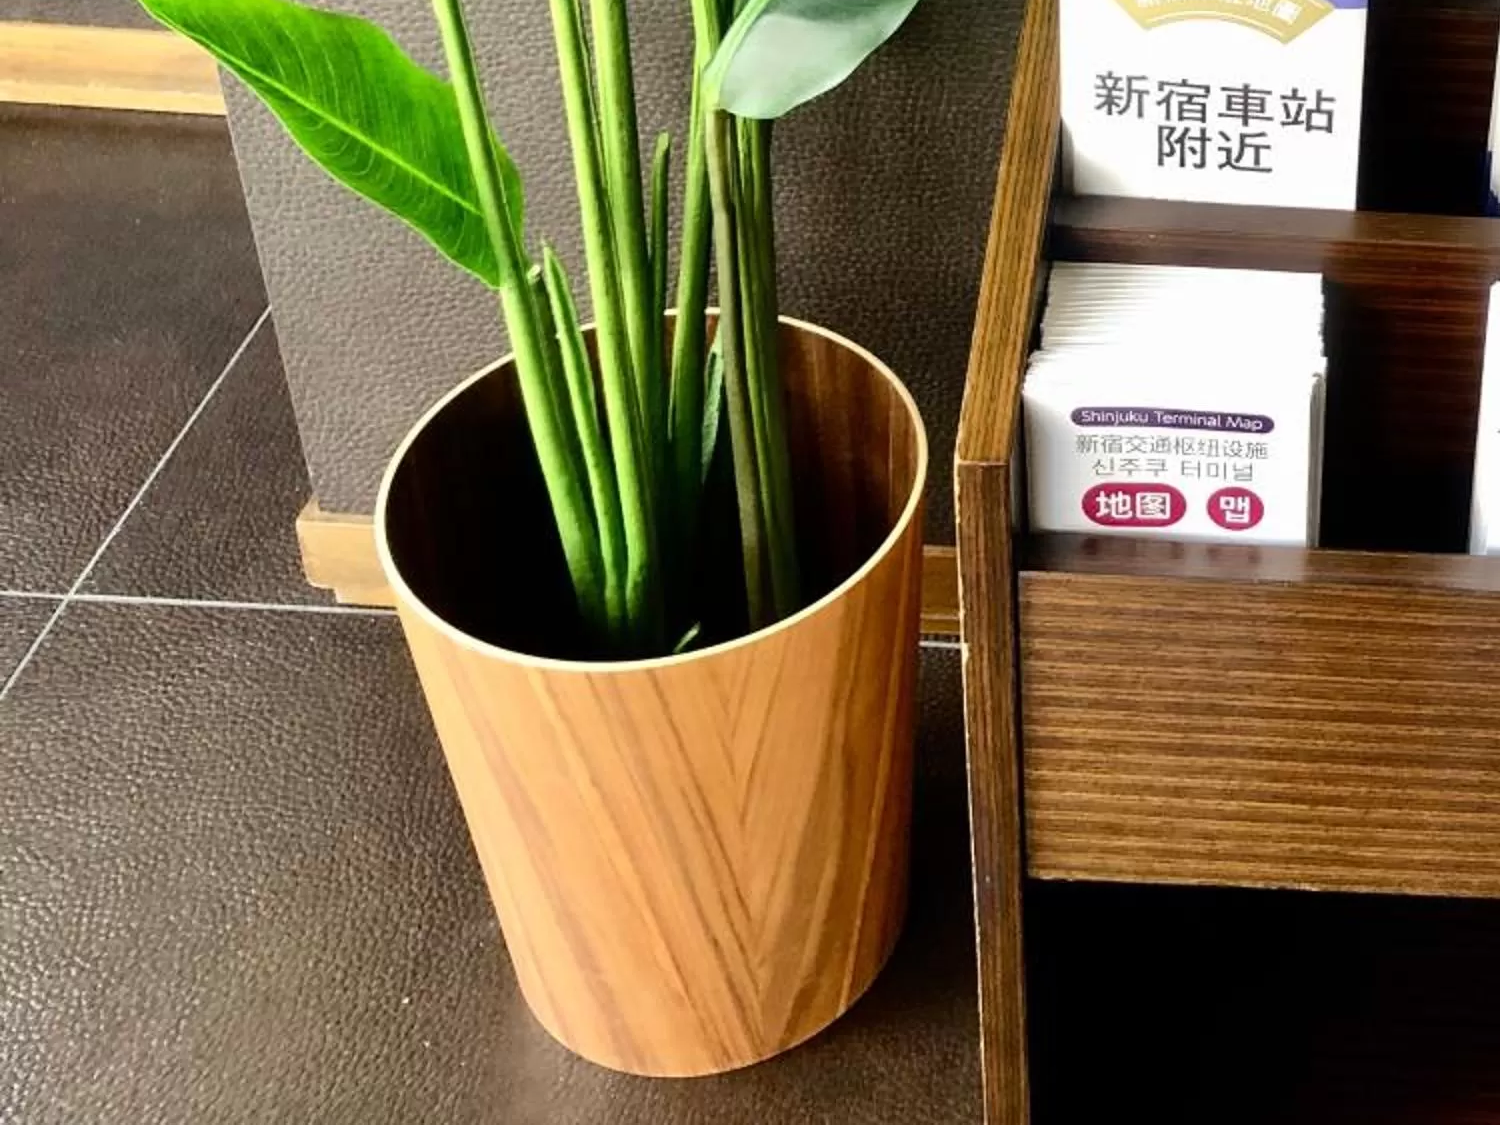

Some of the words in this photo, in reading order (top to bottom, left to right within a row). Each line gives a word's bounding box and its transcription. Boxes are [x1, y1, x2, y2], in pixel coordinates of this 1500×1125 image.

[1093, 70, 1337, 135] 新宿車站
[1157, 124, 1273, 174] 附近
[1081, 410, 1149, 426] Shinjuku
[1154, 411, 1221, 427] Terminal
[1225, 416, 1263, 431] Map
[1075, 434, 1269, 460] 新宿交通枢纽设施
[1091, 457, 1168, 477] 신주쿠
[1180, 460, 1254, 482] 터미널
[1096, 491, 1171, 520] 地图
[1219, 496, 1250, 523] 맵
